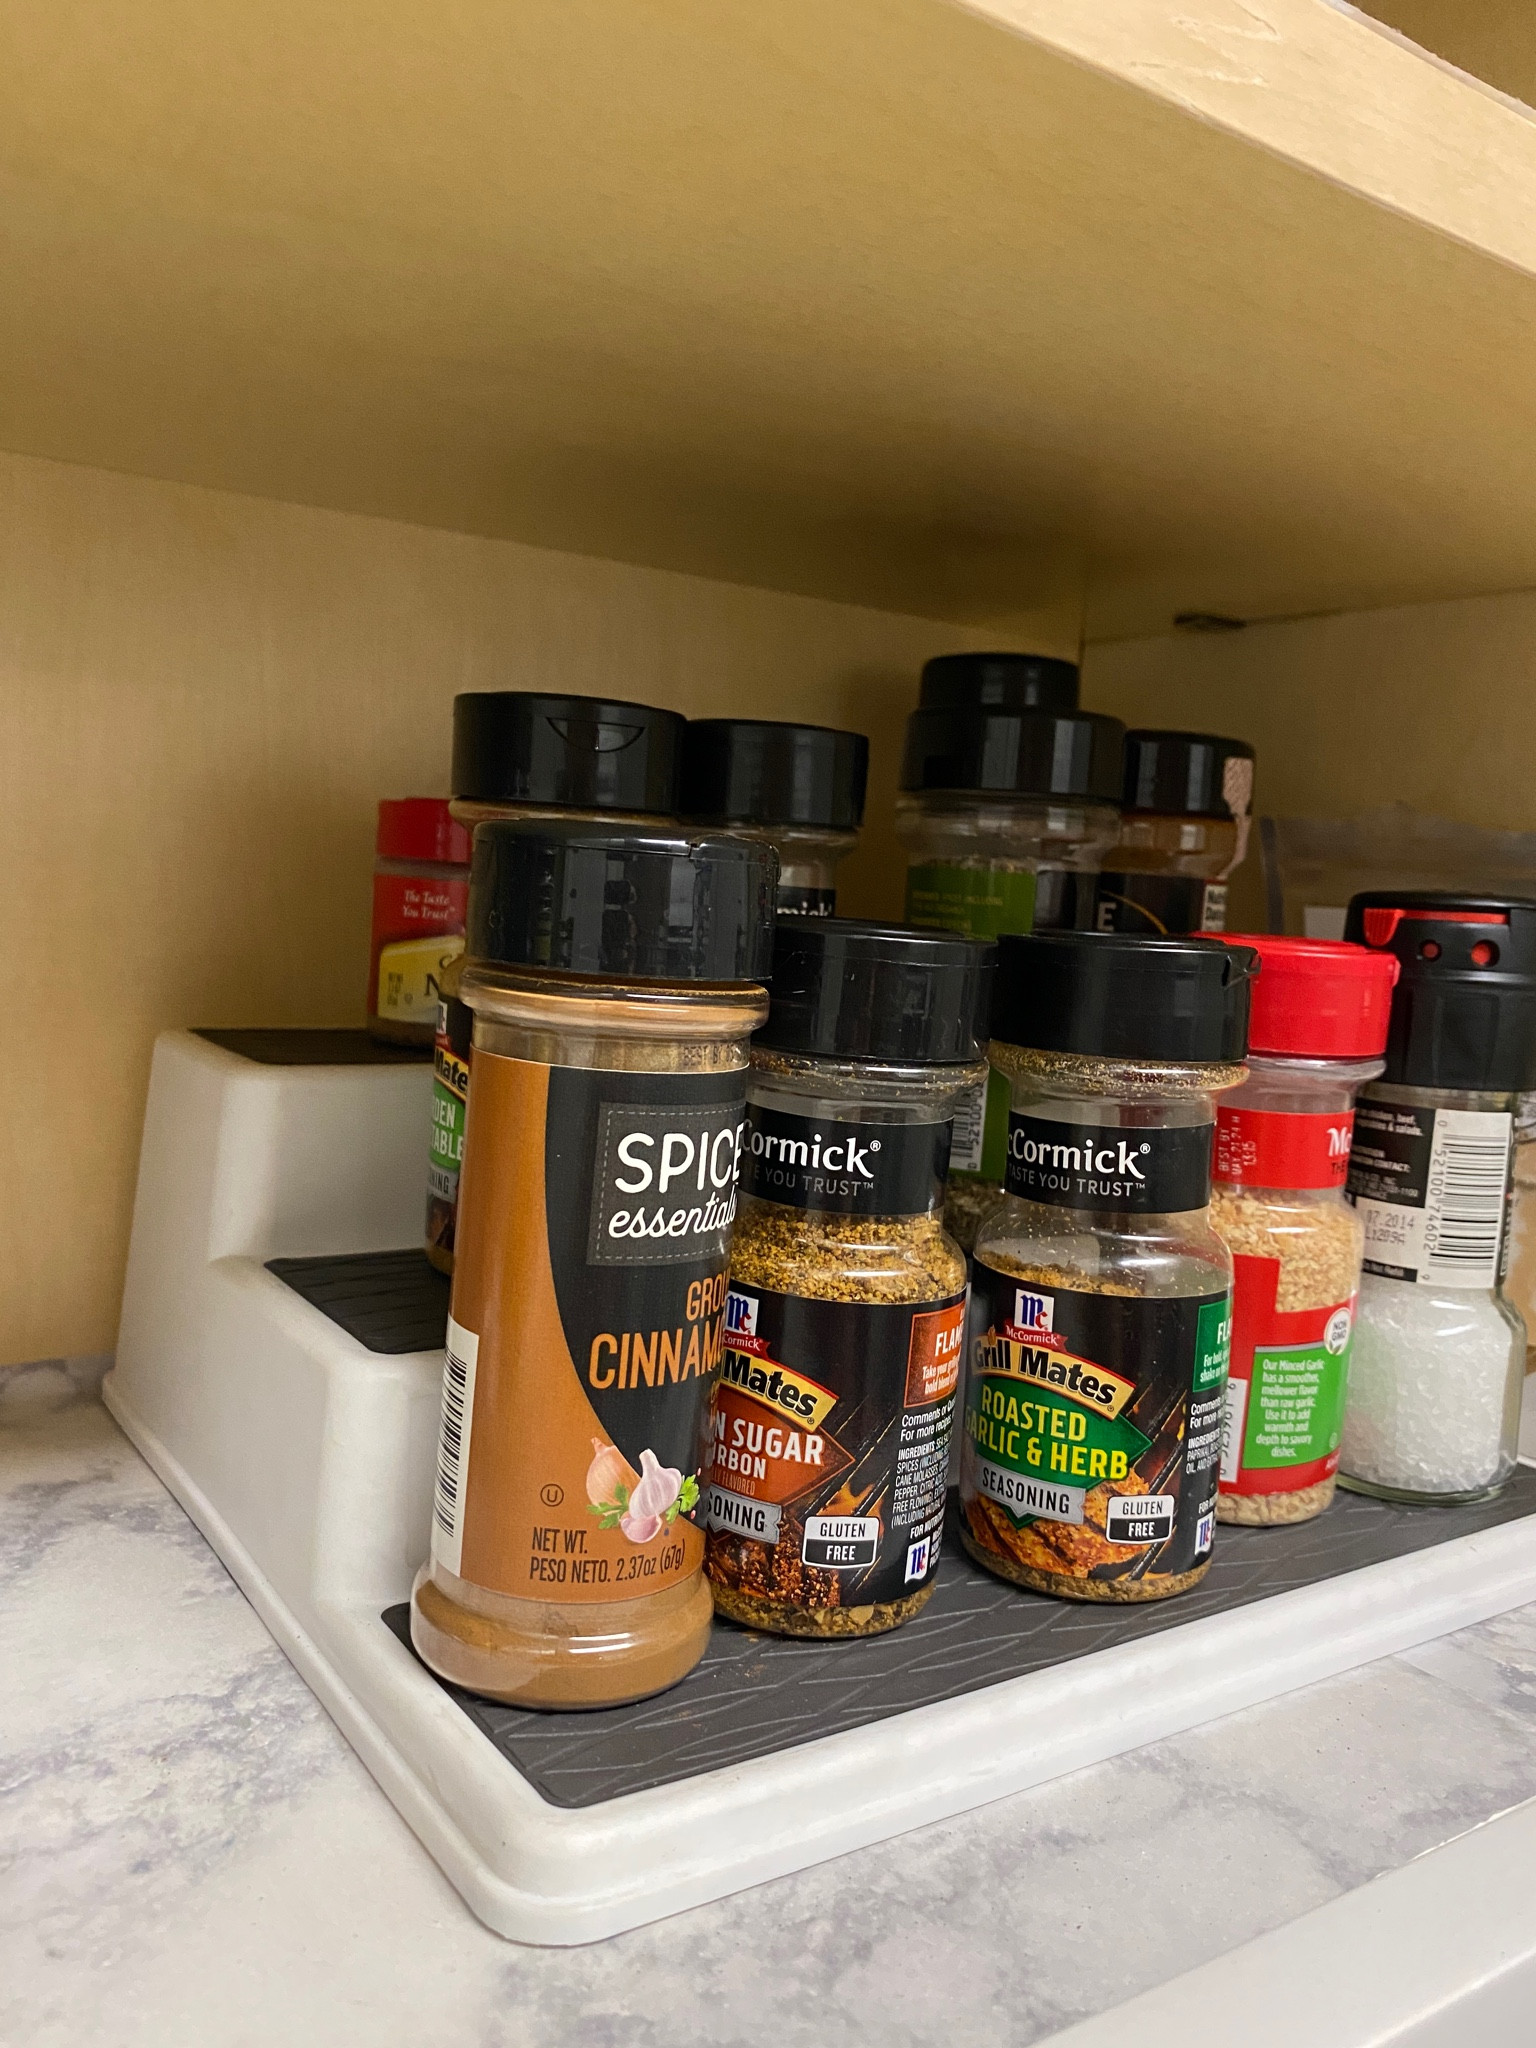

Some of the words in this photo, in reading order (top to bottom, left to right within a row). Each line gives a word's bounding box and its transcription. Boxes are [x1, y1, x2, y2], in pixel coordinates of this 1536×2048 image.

[1327, 1126, 1352, 1157] Mc
[615, 1122, 744, 1194] SPICE
[765, 1166, 796, 1188] YOU
[1039, 1171, 1070, 1191] YOU
[1430, 1149, 1447, 1196] 52100
[1424, 1205, 1441, 1251] 74602
[589, 1315, 724, 1390] CINNAM
[974, 1339, 1012, 1370] Grill
[1018, 1344, 1117, 1405] Mates
[1263, 1358, 1278, 1370] Our
[1279, 1360, 1305, 1371] Minced
[1306, 1359, 1325, 1370] Garlic
[723, 1350, 818, 1416] Mates
[1263, 1371, 1277, 1383] has
[1278, 1374, 1284, 1383] a
[1261, 1384, 1297, 1396] mellower
[1261, 1396, 1279, 1407] than
[1280, 1399, 1295, 1408] raw
[902, 1407, 941, 1427] Comments
[982, 1384, 1087, 1442] ROASTED
[1265, 1408, 1280, 1420] Use
[1280, 1409, 1287, 1420] it
[1288, 1409, 1296, 1420] to
[1296, 1408, 1311, 1420] add
[1190, 1416, 1202, 1429] For
[1264, 1421, 1294, 1432] warmth
[1295, 1421, 1309, 1432] and
[732, 1418, 825, 1465] SUGAR
[901, 1429, 914, 1442] For
[916, 1424, 935, 1439] more
[1256, 1433, 1280, 1446] depth
[1280, 1434, 1289, 1445] to
[964, 1405, 1020, 1460] GARLIC
[1026, 1438, 1042, 1467] &
[1050, 1442, 1128, 1480] HERB
[897, 1459, 919, 1474] SPICES
[896, 1473, 912, 1487] CANE
[983, 1467, 1070, 1514] SEASONING
[893, 1500, 908, 1514] FREE
[1122, 1501, 1163, 1515] GLUTEN
[820, 1522, 866, 1538] GLUTEN
[910, 1524, 924, 1539] FOR
[1128, 1522, 1155, 1537] FREE
[532, 1527, 560, 1552] NET
[564, 1530, 588, 1554] WT.
[530, 1556, 567, 1583] PESO
[571, 1559, 611, 1583] NETO.
[616, 1554, 657, 1582] 2.37oz
[660, 1538, 686, 1574] (67g)
[825, 1545, 856, 1561] FREE
